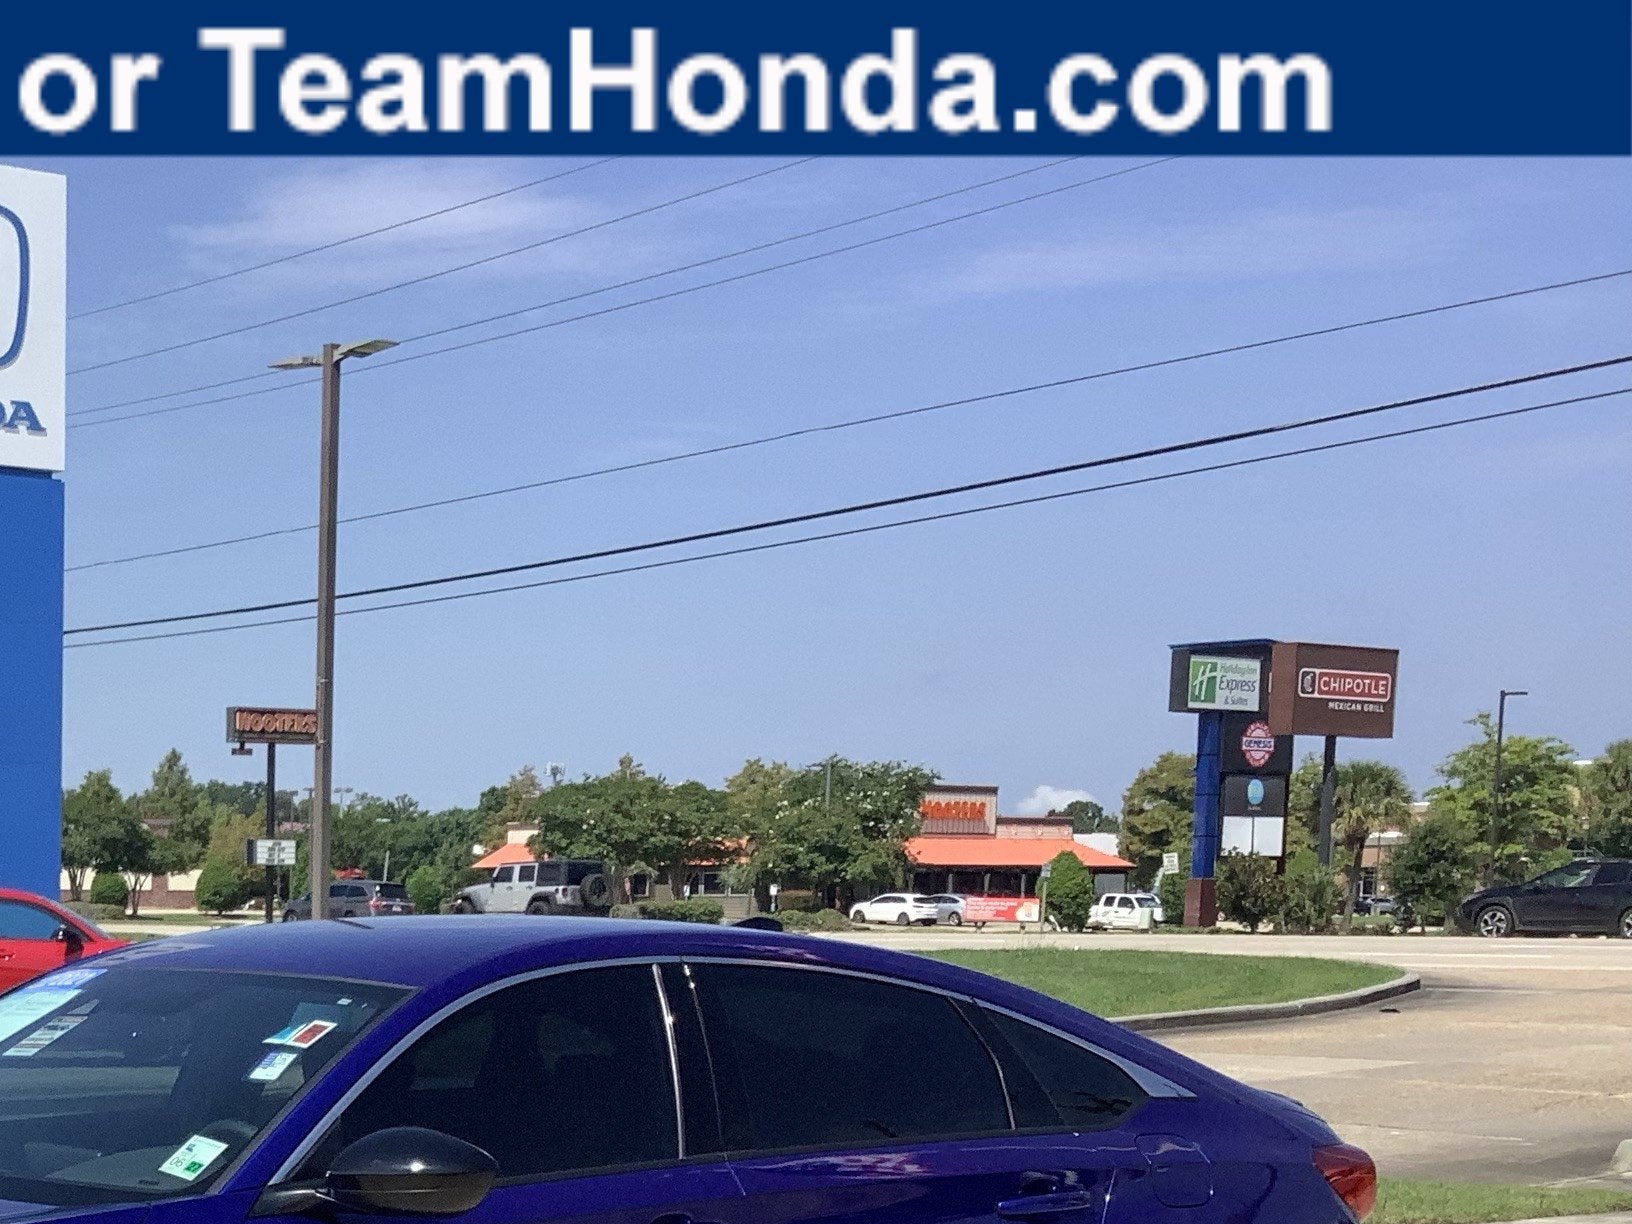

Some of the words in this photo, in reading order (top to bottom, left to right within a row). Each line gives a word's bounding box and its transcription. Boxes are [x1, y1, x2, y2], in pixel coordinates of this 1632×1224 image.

[1218, 674, 1257, 694] Express
[1320, 677, 1387, 695] CHIPOTLE
[1328, 701, 1362, 711] MEXICAN
